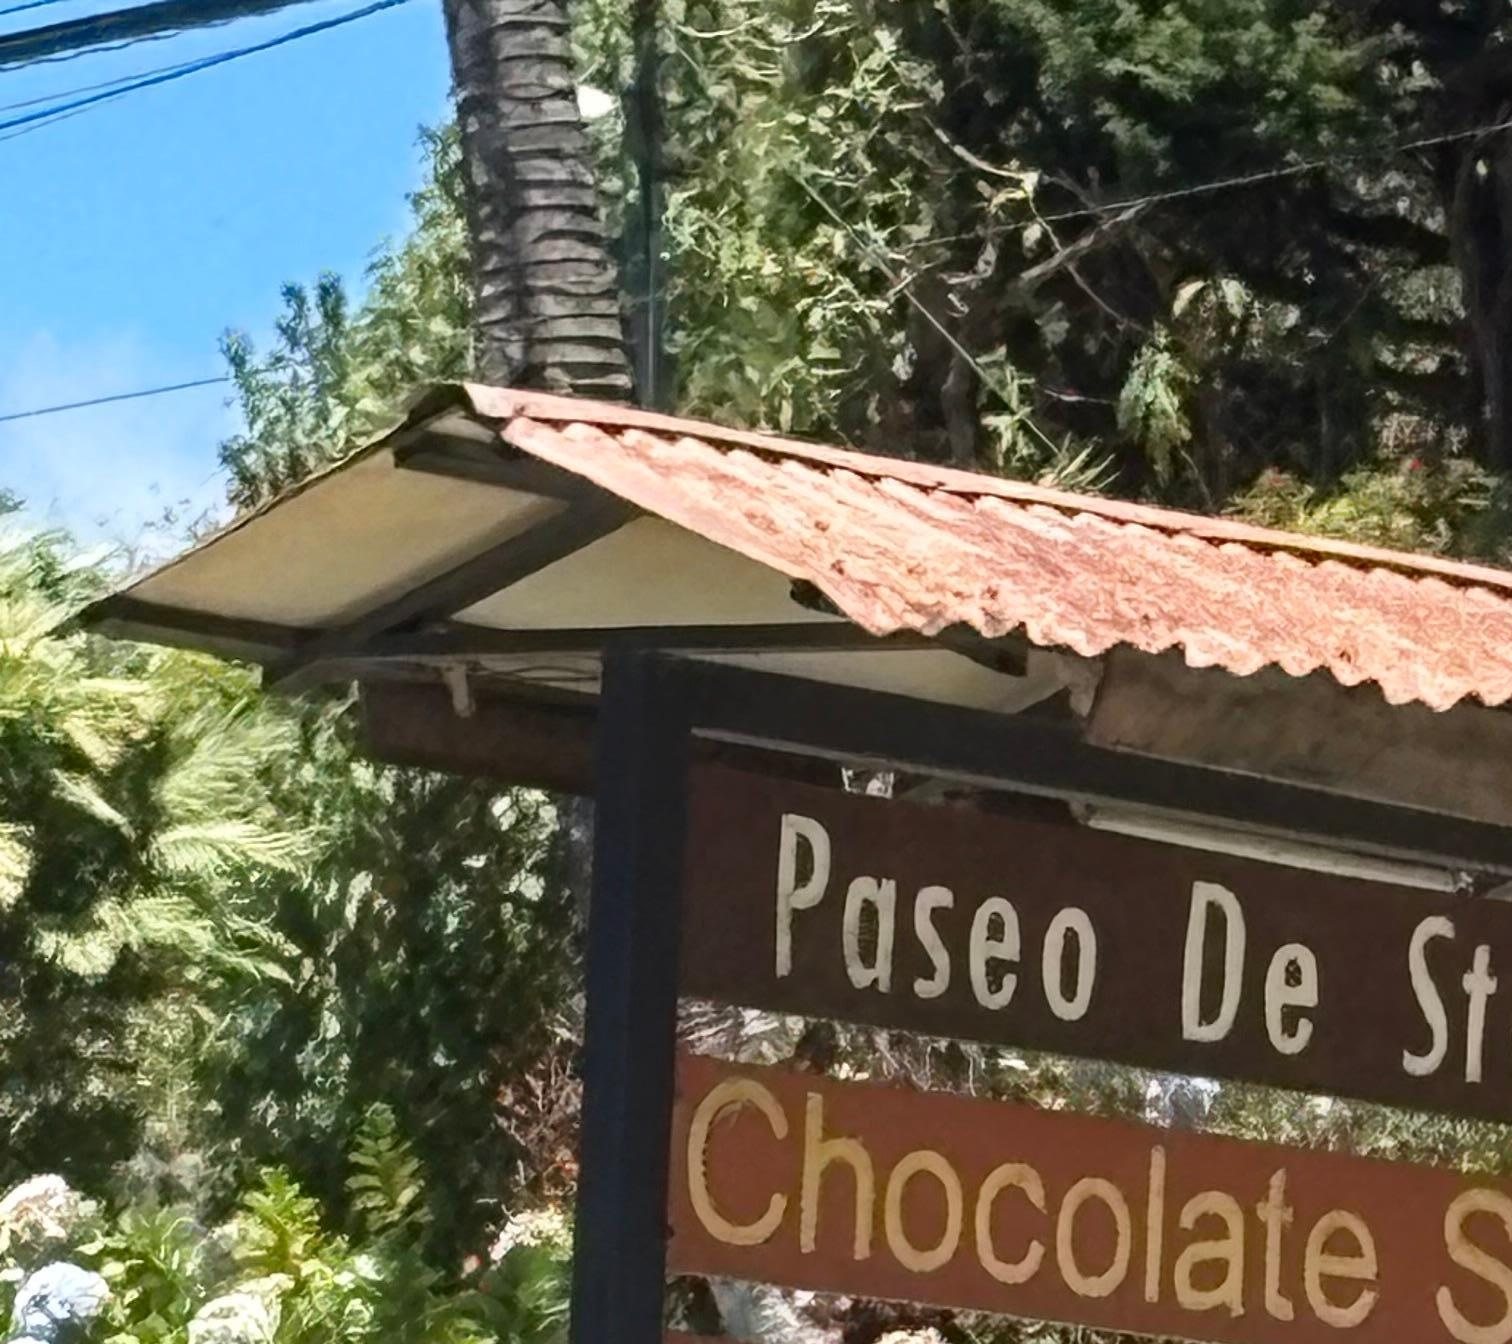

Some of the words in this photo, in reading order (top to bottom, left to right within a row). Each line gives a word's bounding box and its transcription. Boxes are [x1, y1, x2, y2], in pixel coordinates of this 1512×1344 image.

[776, 813, 1097, 1022] Paseo
[1182, 881, 1319, 1055] De
[686, 1077, 1380, 1327] Chocolate
